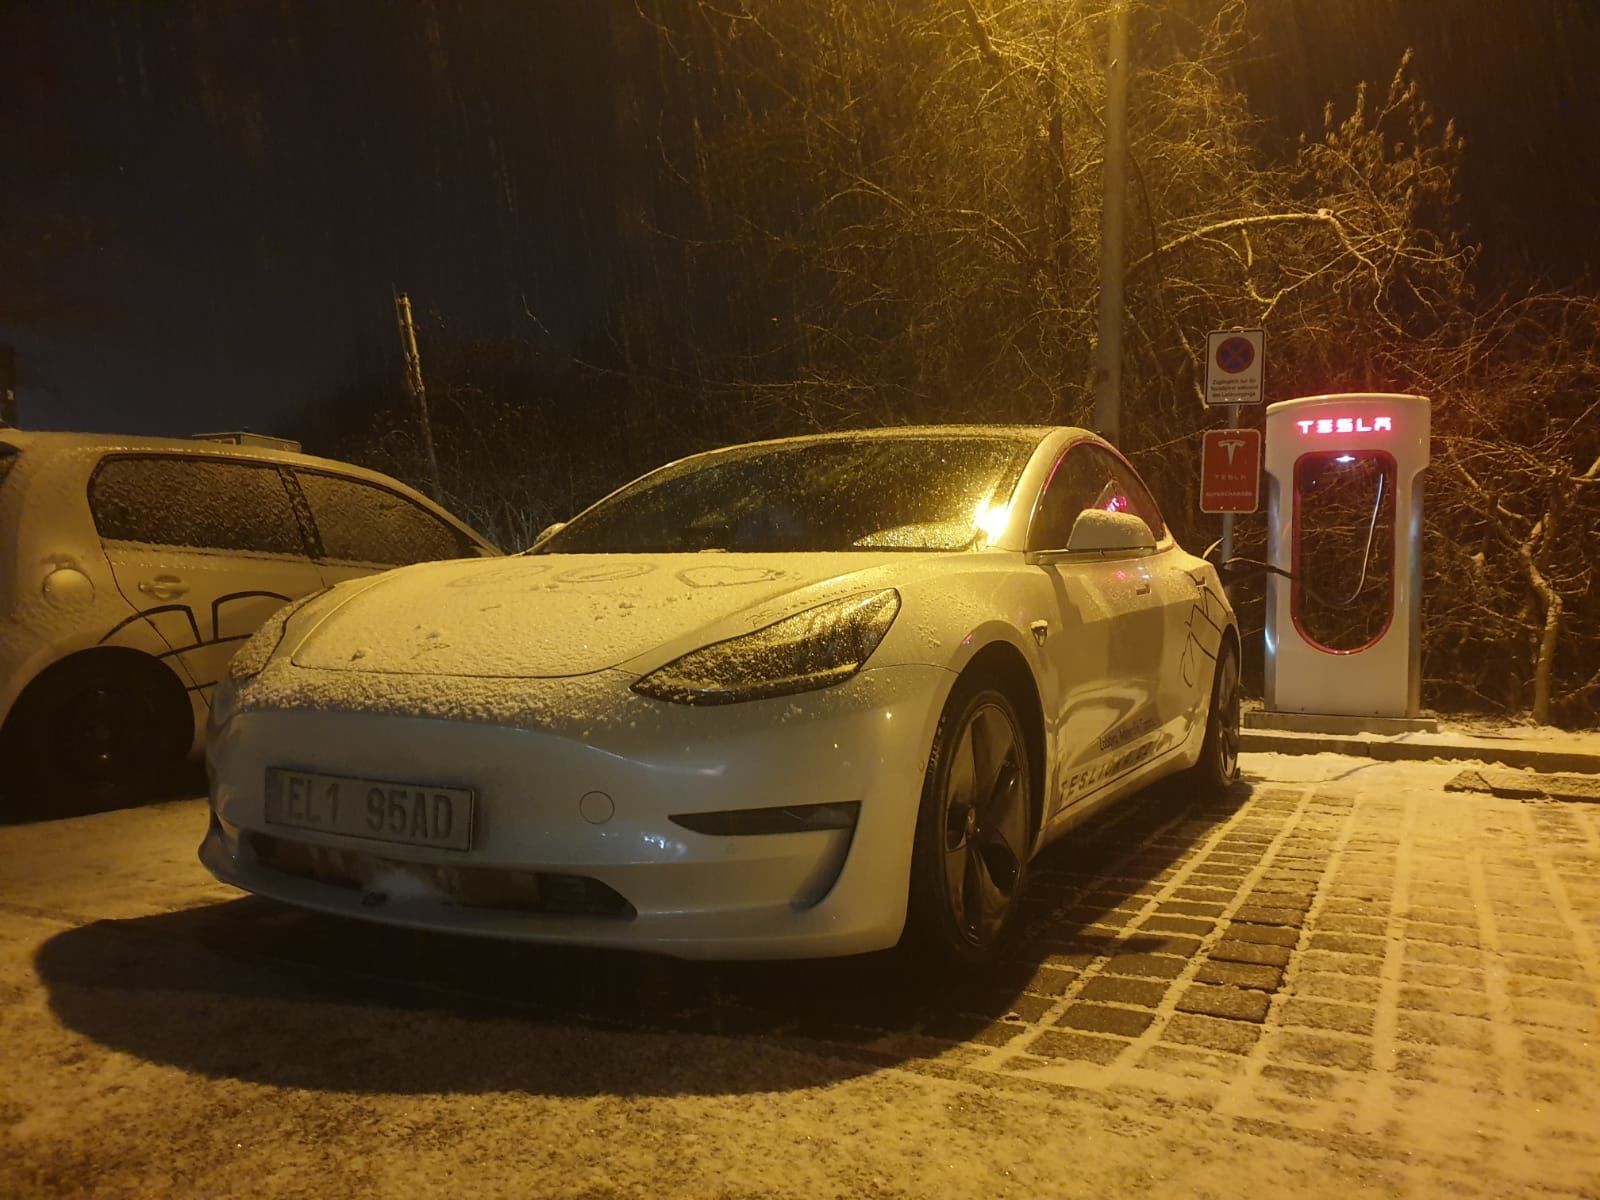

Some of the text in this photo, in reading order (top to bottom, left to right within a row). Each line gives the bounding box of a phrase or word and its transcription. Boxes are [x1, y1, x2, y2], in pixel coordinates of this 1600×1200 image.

[1297, 417, 1391, 434] TESLA
[1215, 473, 1247, 481] TESLA
[365, 787, 453, 841] 95AD
